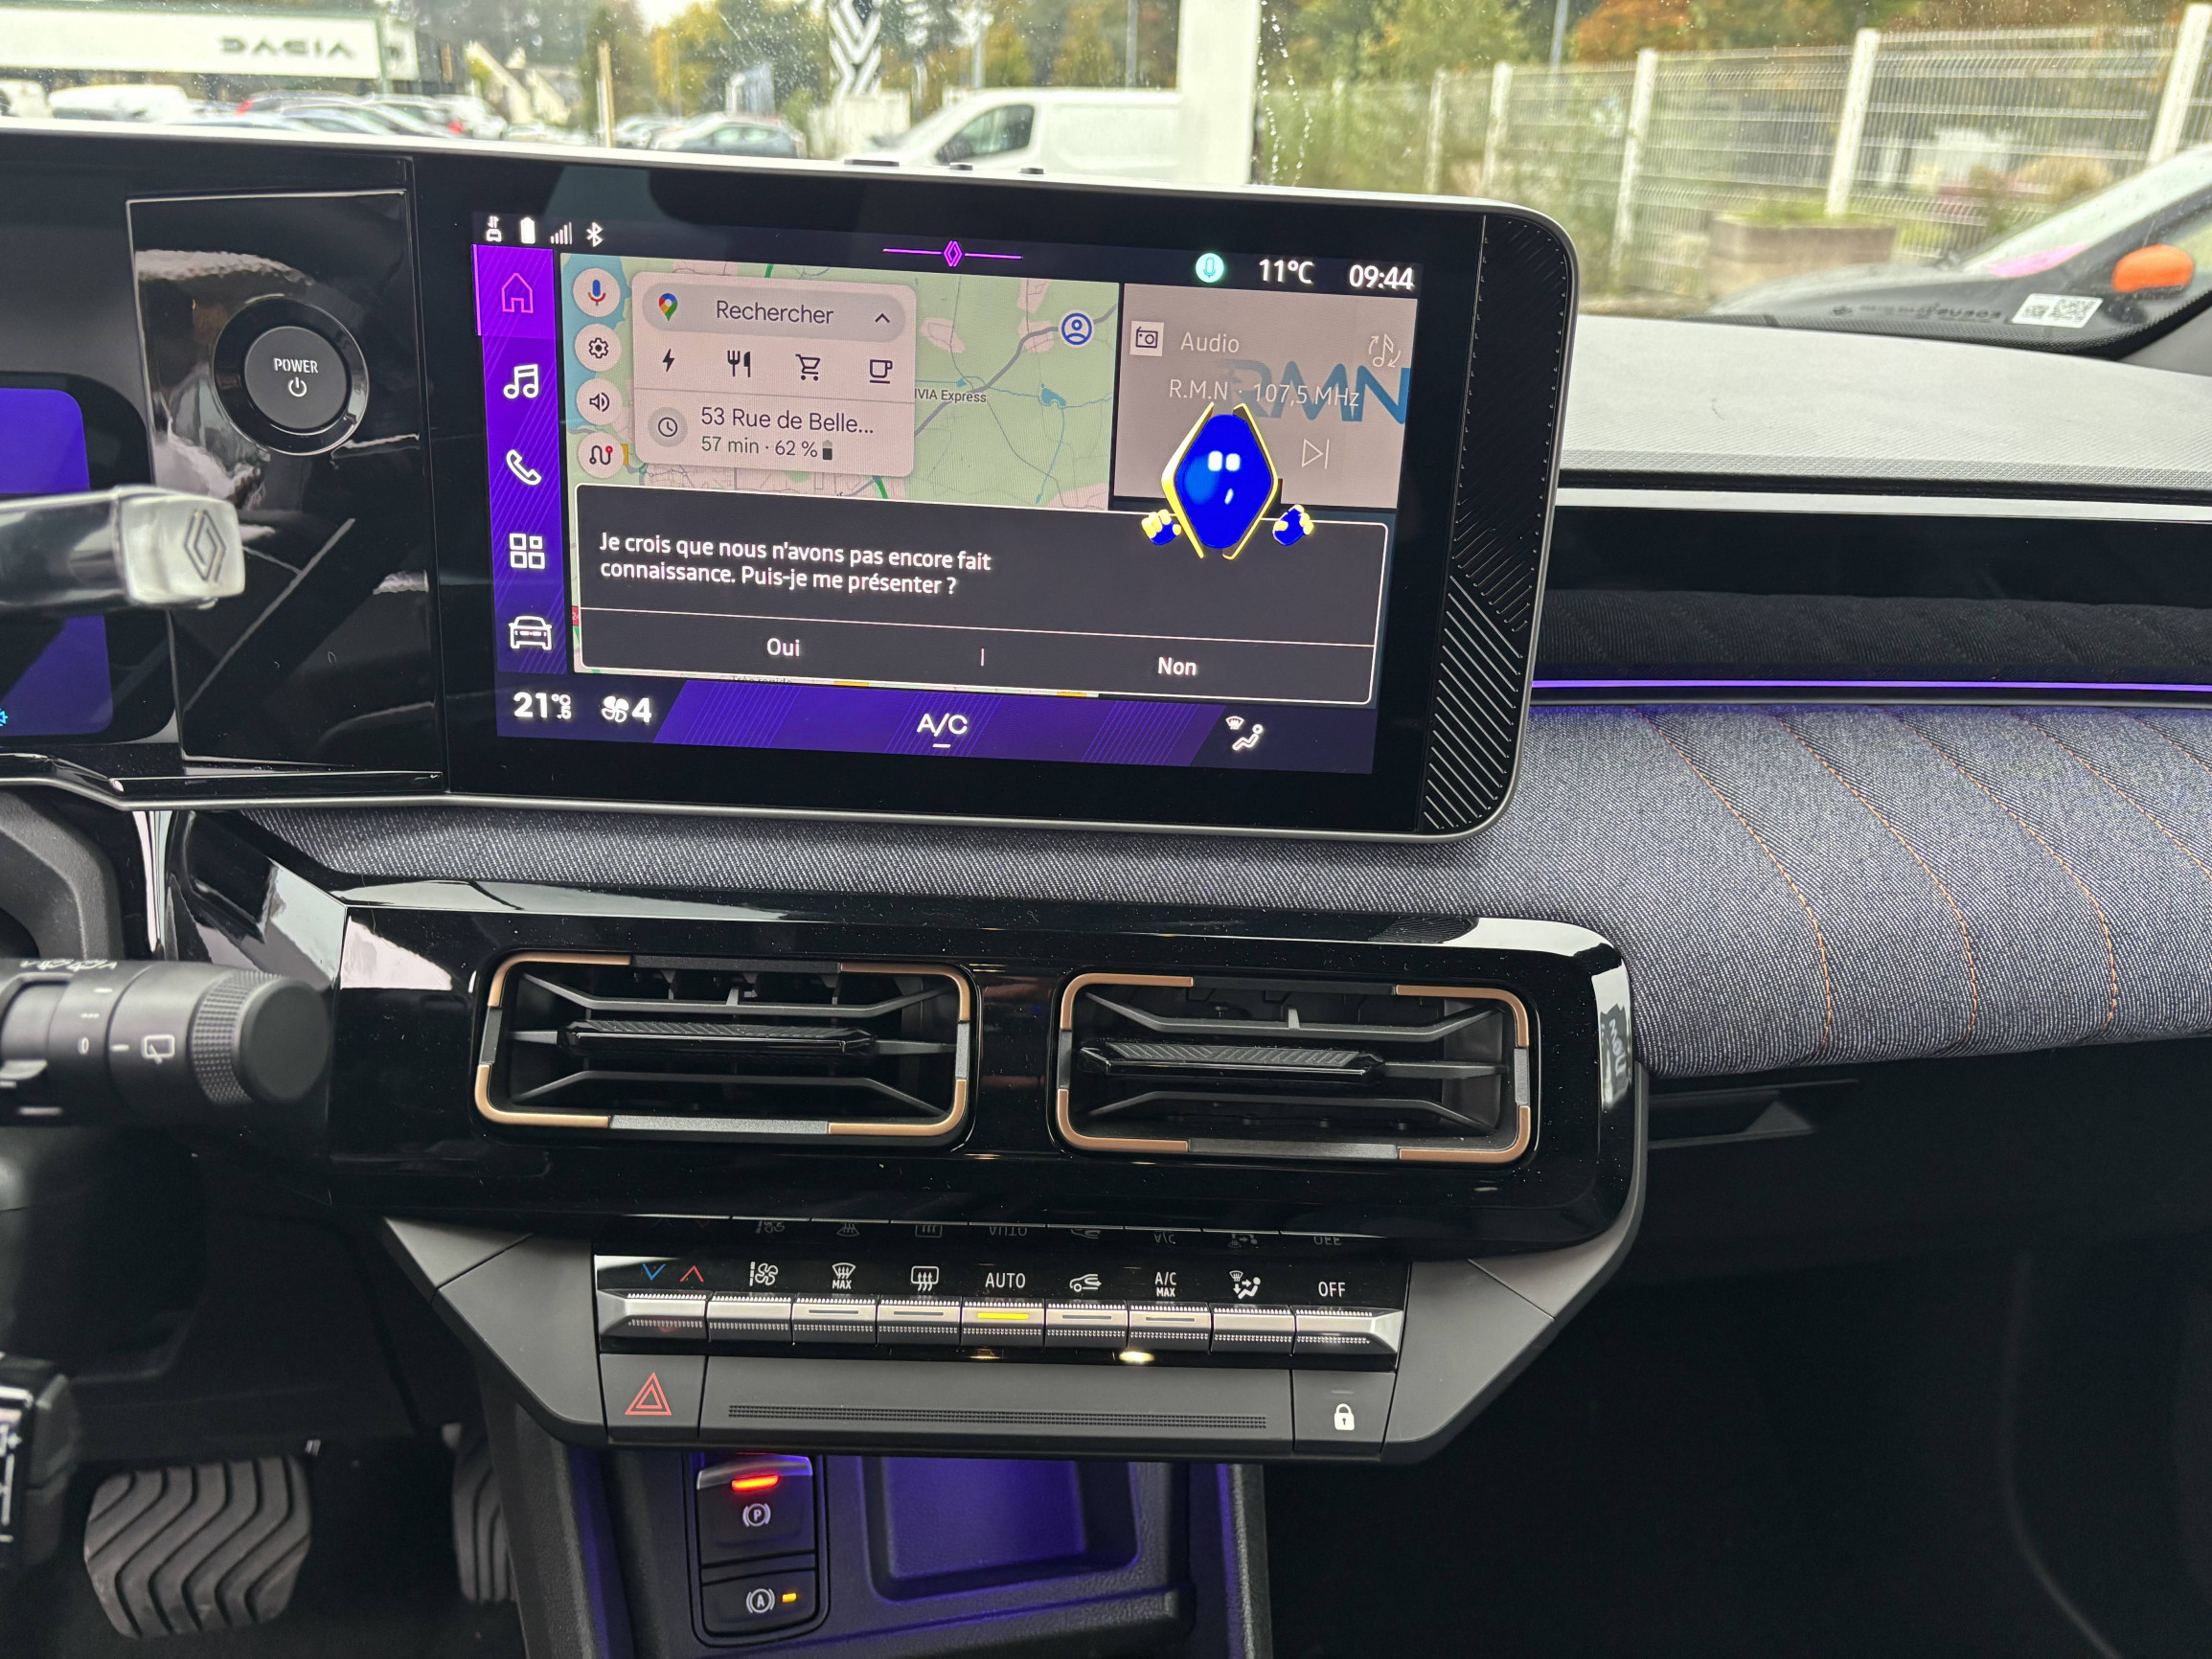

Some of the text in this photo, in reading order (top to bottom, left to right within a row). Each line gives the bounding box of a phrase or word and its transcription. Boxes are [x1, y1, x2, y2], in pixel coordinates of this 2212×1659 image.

[220, 37, 354, 57] DACIA
[1349, 265, 1414, 290] 09:44
[716, 300, 833, 326] Rechercher
[1180, 332, 1240, 353] Audio
[274, 357, 318, 374] POWER
[941, 390, 987, 403] Express
[1169, 379, 1359, 407] R.M.N 107,5 MHz
[701, 407, 874, 435] 53 Rue de Belle...
[701, 437, 818, 458] 57 min 62 %
[599, 533, 992, 571] Je crois que nous n'avons pas encore fait
[601, 561, 957, 595] connaissance. Puis-je me présenter ?
[766, 638, 800, 657] Oui
[1157, 657, 1197, 676] Non
[632, 697, 651, 723] 4
[916, 713, 968, 738] A/C
[832, 1279, 852, 1290] MAX
[985, 1272, 1026, 1289] AUTO
[1154, 1271, 1176, 1287] A/C
[1155, 1285, 1176, 1299] MAX
[1318, 1281, 1346, 1298] OFF
